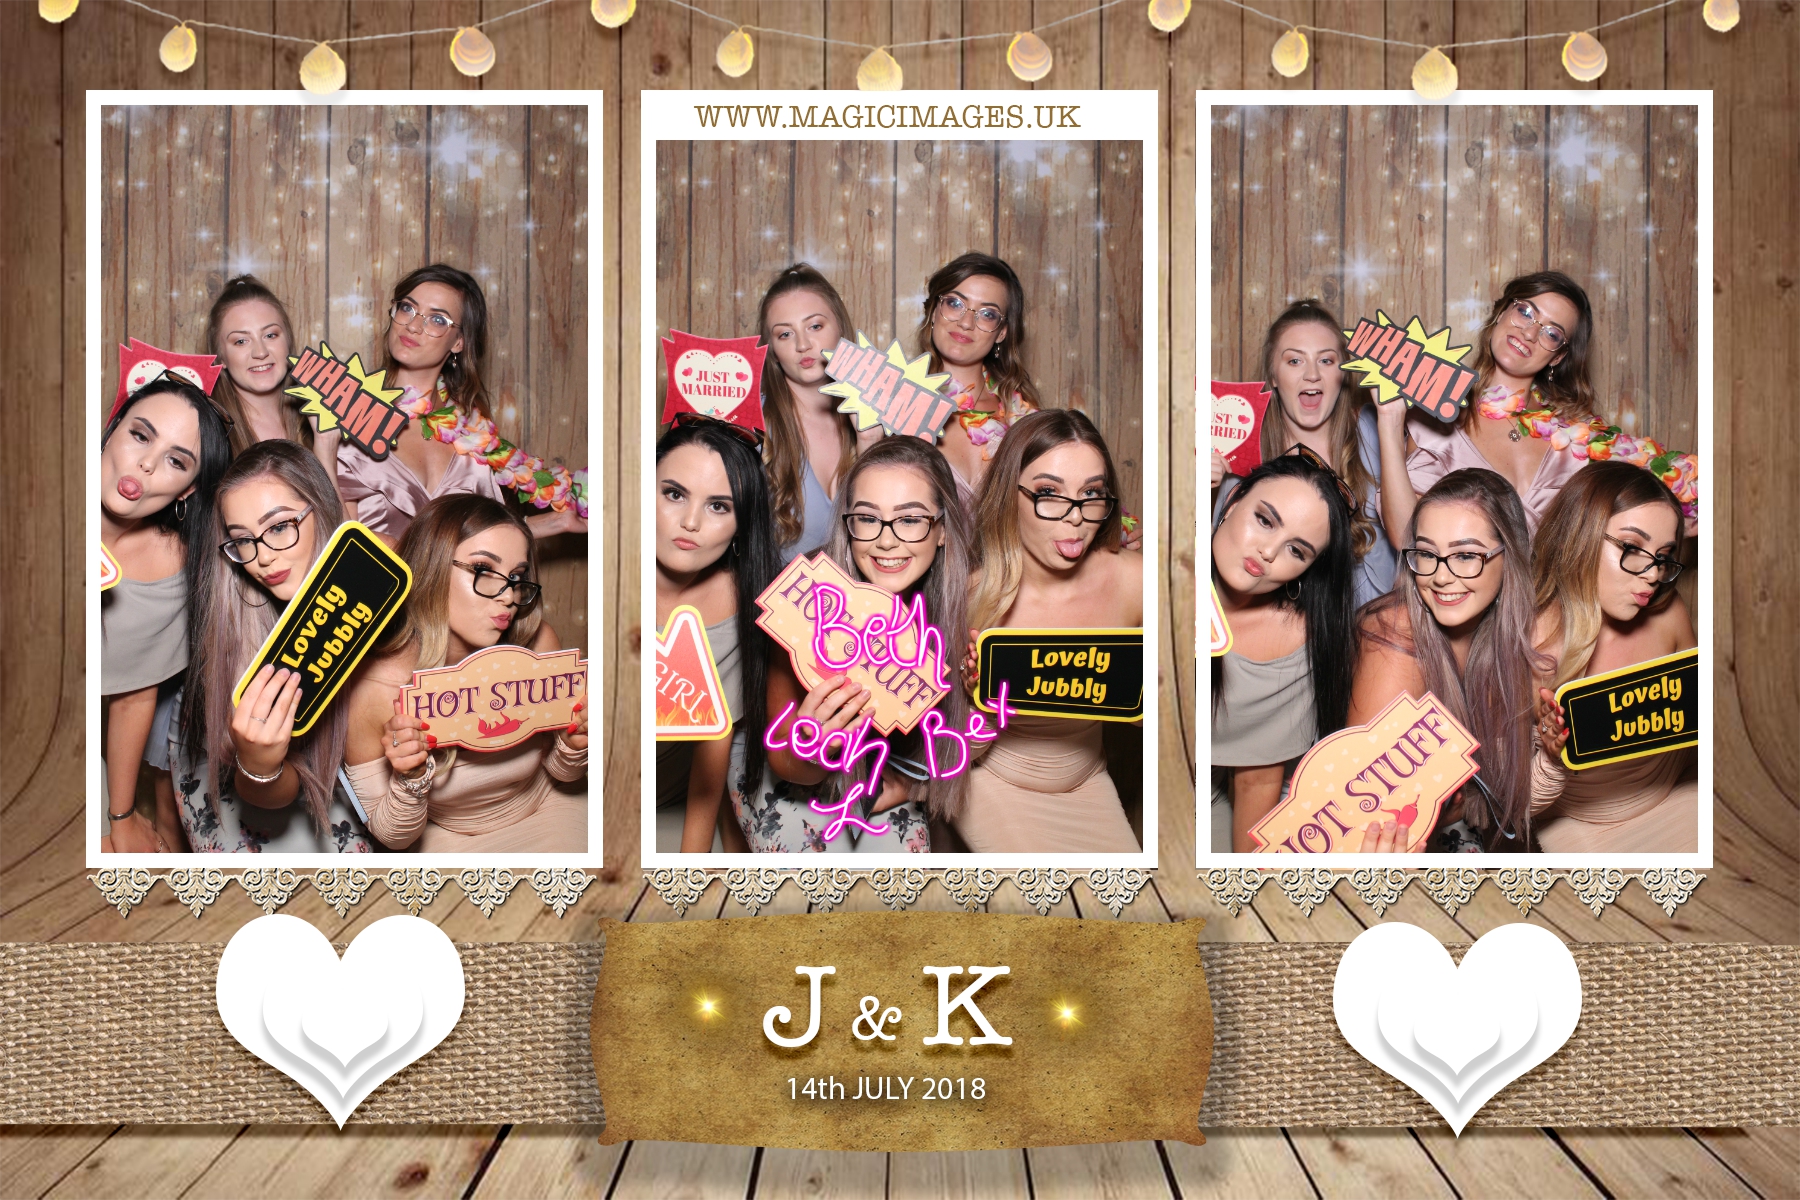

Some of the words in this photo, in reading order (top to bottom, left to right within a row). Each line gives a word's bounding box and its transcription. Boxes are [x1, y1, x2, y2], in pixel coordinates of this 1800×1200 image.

[681, 382, 747, 399] MARRIED
[695, 369, 730, 384] JUST
[1345, 319, 1477, 419] WHAM!
[289, 347, 407, 456] WHAM!
[824, 340, 954, 444] WHAM!
[1211, 424, 1248, 440] RIED
[280, 584, 348, 669] Lovely
[306, 601, 374, 684] Jubbly
[1031, 646, 1112, 674] Lovely
[413, 686, 481, 720] HOT
[489, 670, 587, 711] STUFF
[1026, 676, 1107, 705] Jubbly
[1608, 675, 1683, 714] Lovely
[1610, 707, 1686, 742] Jubbly
[1344, 706, 1451, 814] STUFF
